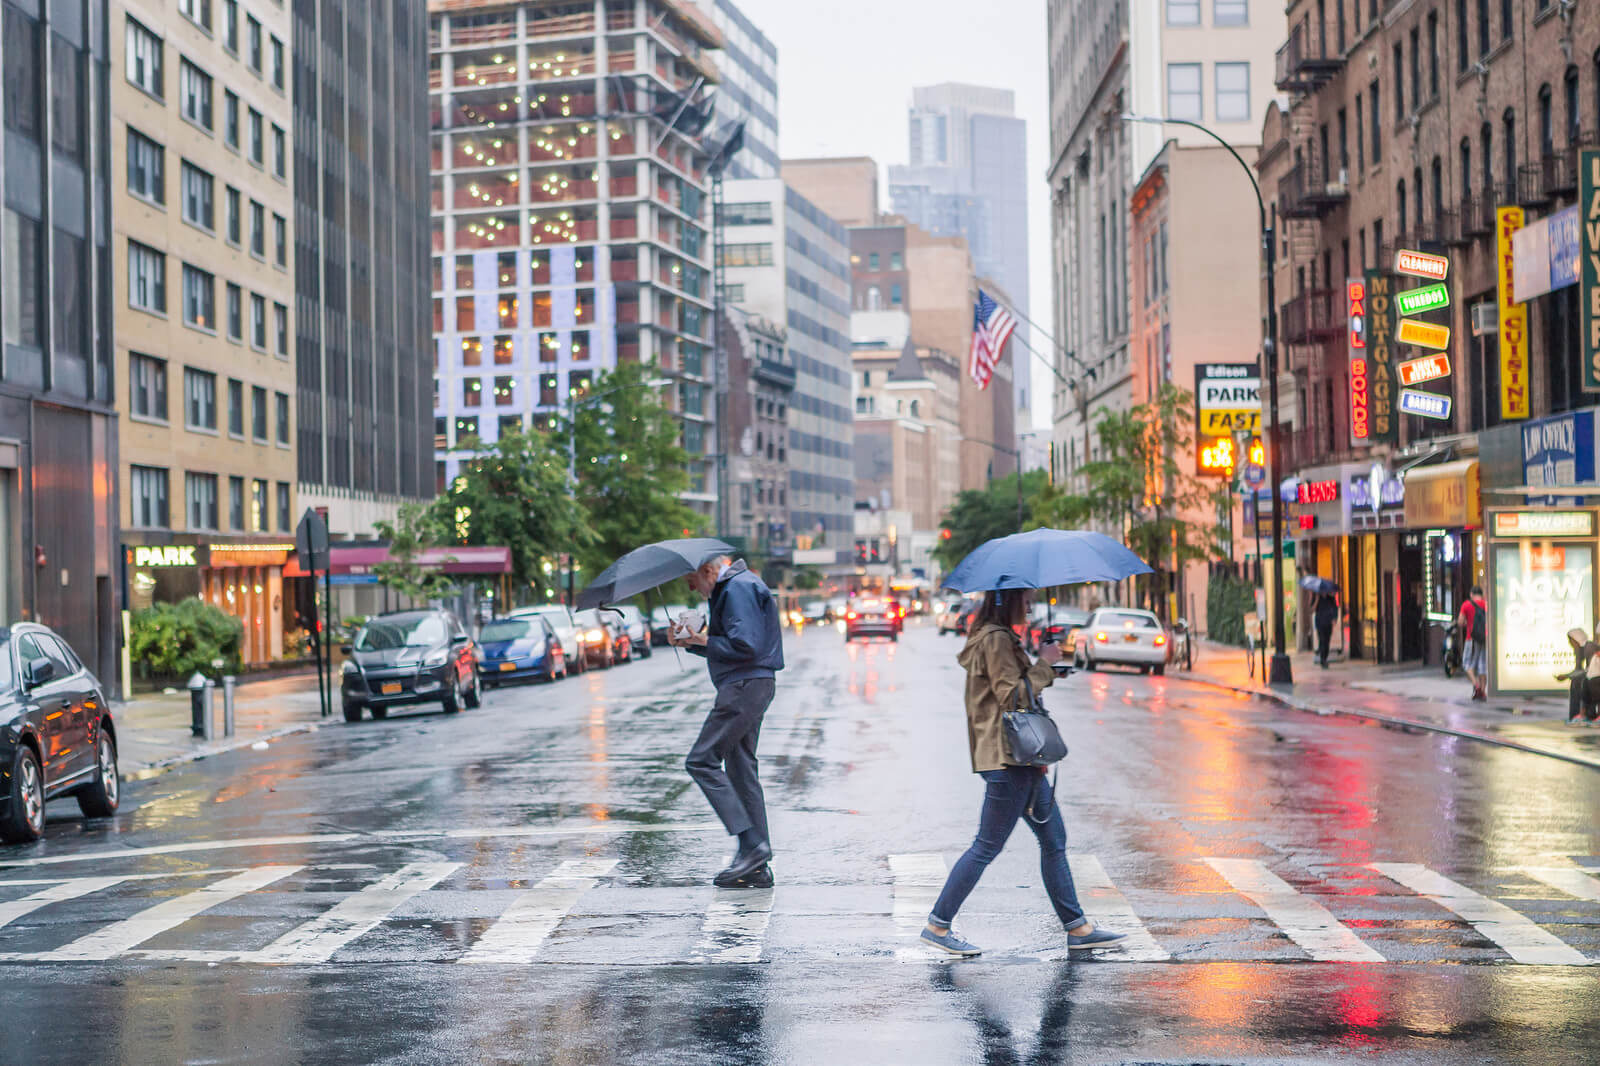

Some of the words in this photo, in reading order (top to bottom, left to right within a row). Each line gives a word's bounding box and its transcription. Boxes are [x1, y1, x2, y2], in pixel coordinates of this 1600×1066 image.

[1401, 255, 1444, 275] CLEANERS
[1403, 289, 1444, 310] TUXEDOS
[1349, 283, 1364, 349] BAL
[1371, 277, 1389, 434] MORTGAGES
[1205, 365, 1248, 378] Edison
[1207, 387, 1259, 401] PARK
[1351, 358, 1368, 438] BONDS
[1209, 413, 1260, 428] FAST
[1523, 426, 1542, 463] LAW
[1542, 417, 1576, 457] OFFICE
[136, 546, 197, 566] PARK
[1508, 575, 1584, 601] NOW
[1505, 601, 1585, 626] OPEN
